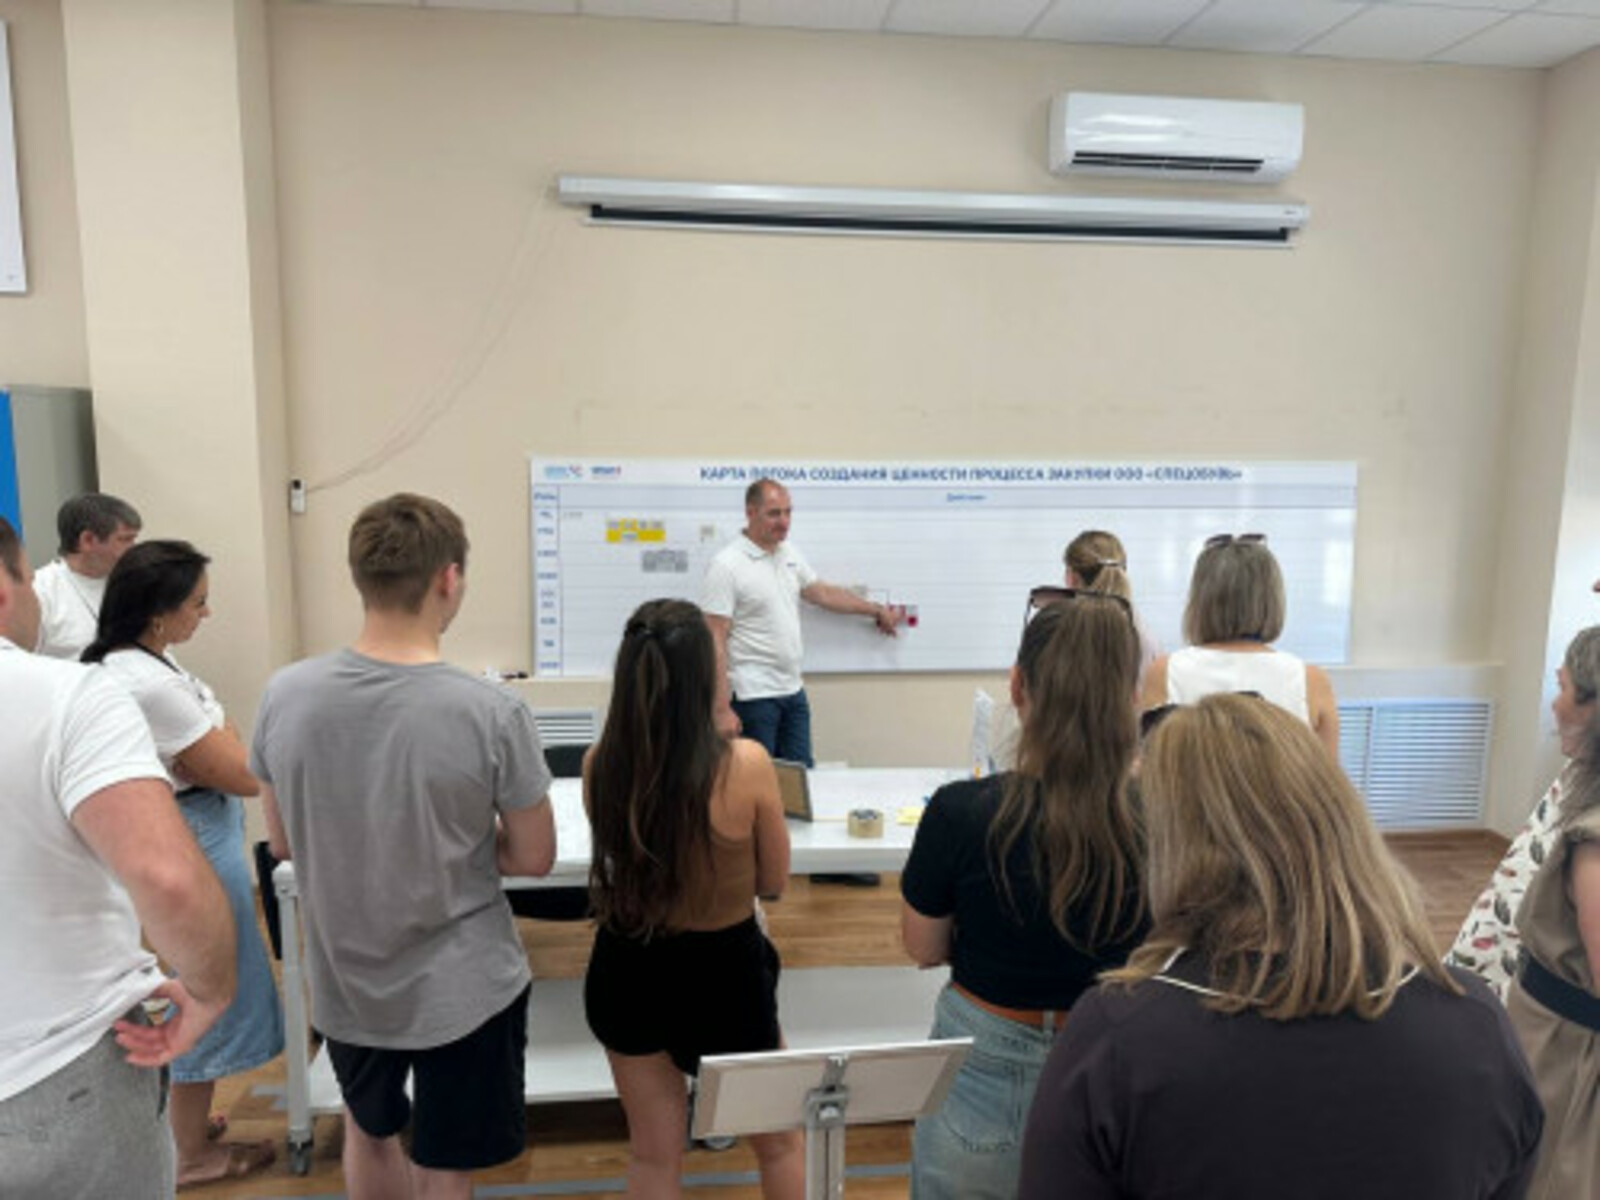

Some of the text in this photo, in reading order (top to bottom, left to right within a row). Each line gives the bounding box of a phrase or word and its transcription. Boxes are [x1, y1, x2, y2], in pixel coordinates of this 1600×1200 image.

[700, 467, 746, 481] КАРТА
[809, 467, 887, 482] СОЗДАНИЯ
[892, 467, 967, 482] ЦЕННОСТИ
[969, 467, 1044, 482] ПРОЦЕССА
[1047, 467, 1111, 481] ЗАКУПКИ
[1114, 467, 1143, 481] ООО
